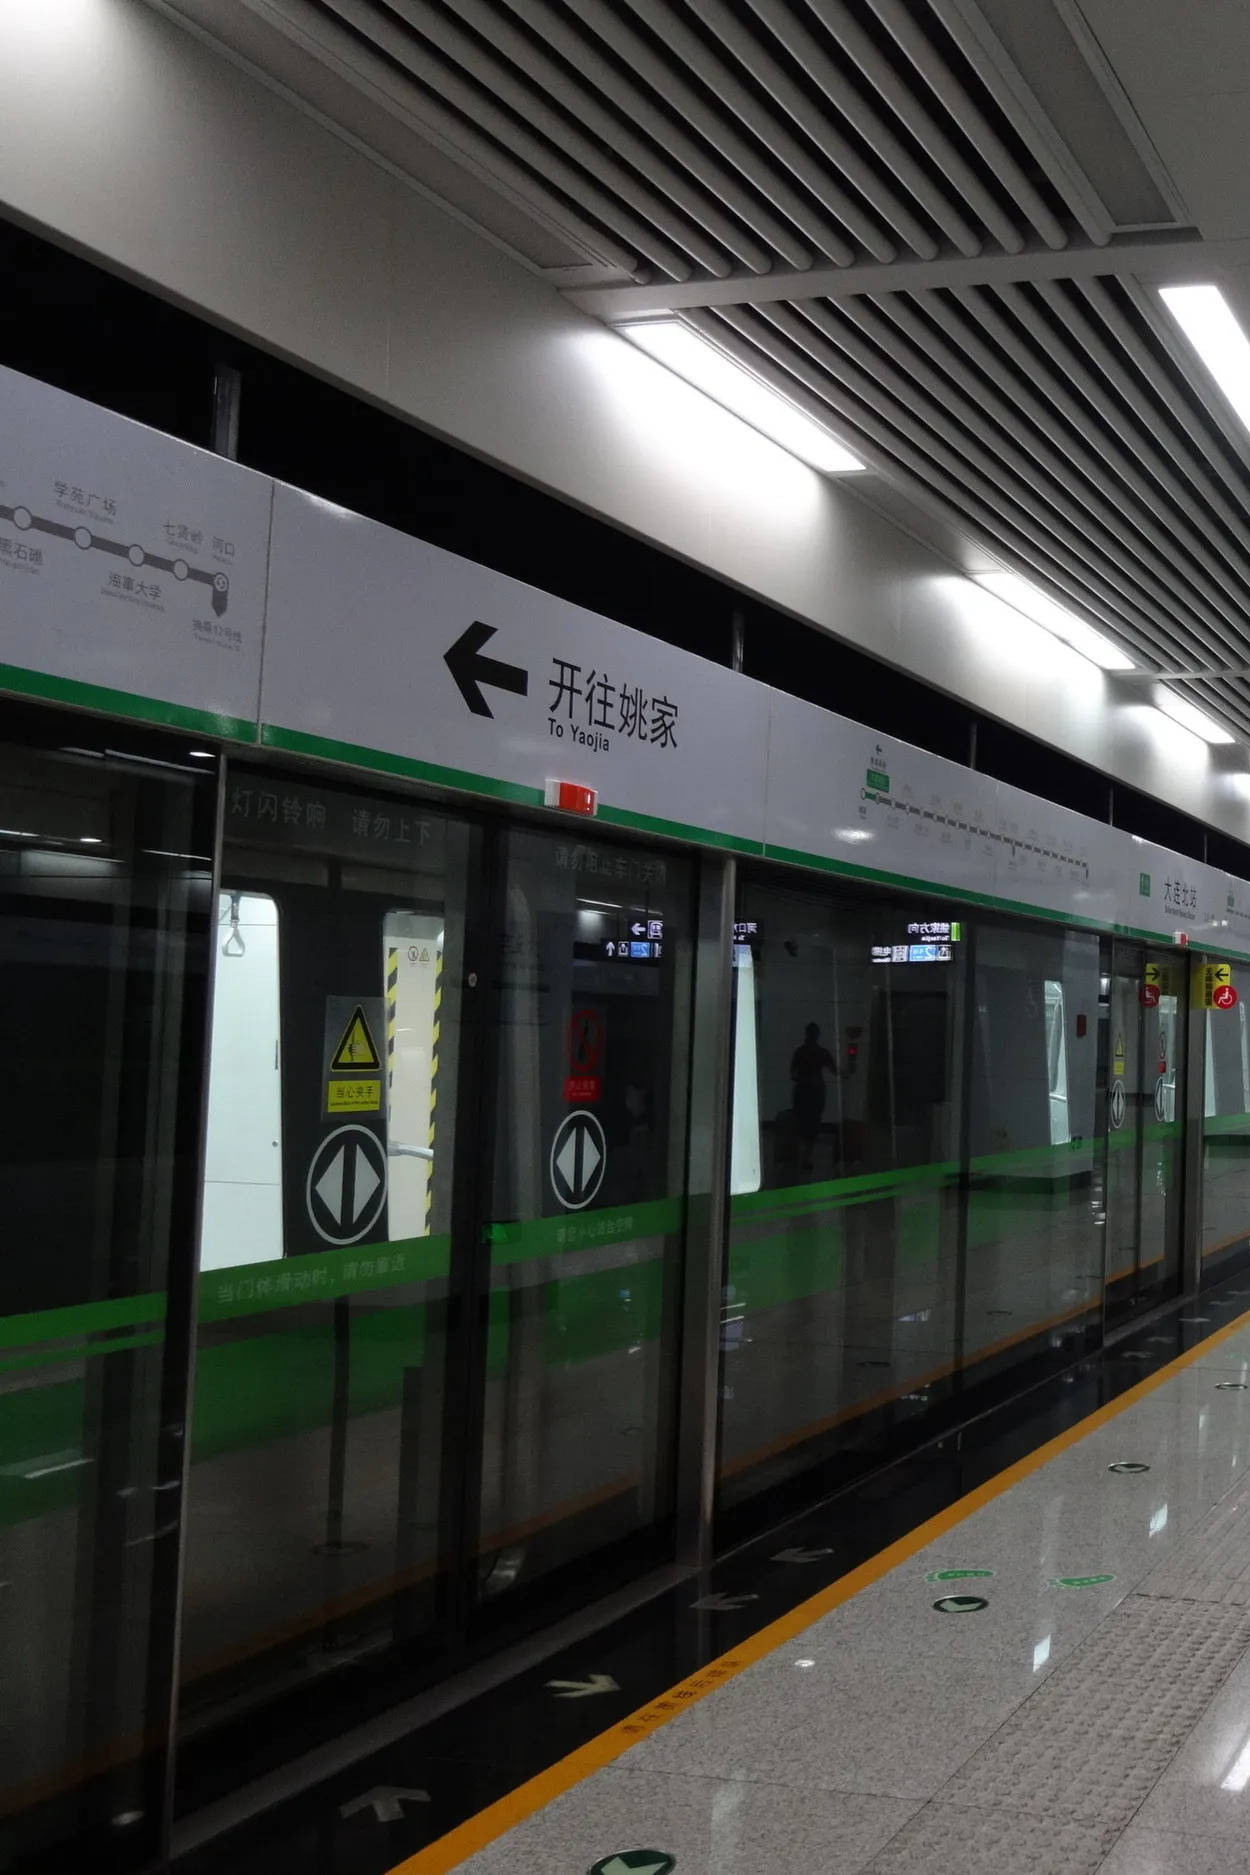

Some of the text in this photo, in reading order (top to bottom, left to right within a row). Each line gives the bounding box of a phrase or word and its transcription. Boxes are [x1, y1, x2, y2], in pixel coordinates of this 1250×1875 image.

[212, 536, 236, 557] 河口
[549, 657, 678, 749] 开往姚家
[548, 717, 610, 752] To Yaojia
[230, 786, 432, 846] 灯闪铃响 请勿上下
[1164, 876, 1197, 908] 大连北站
[336, 1085, 374, 1099] 当心夹手
